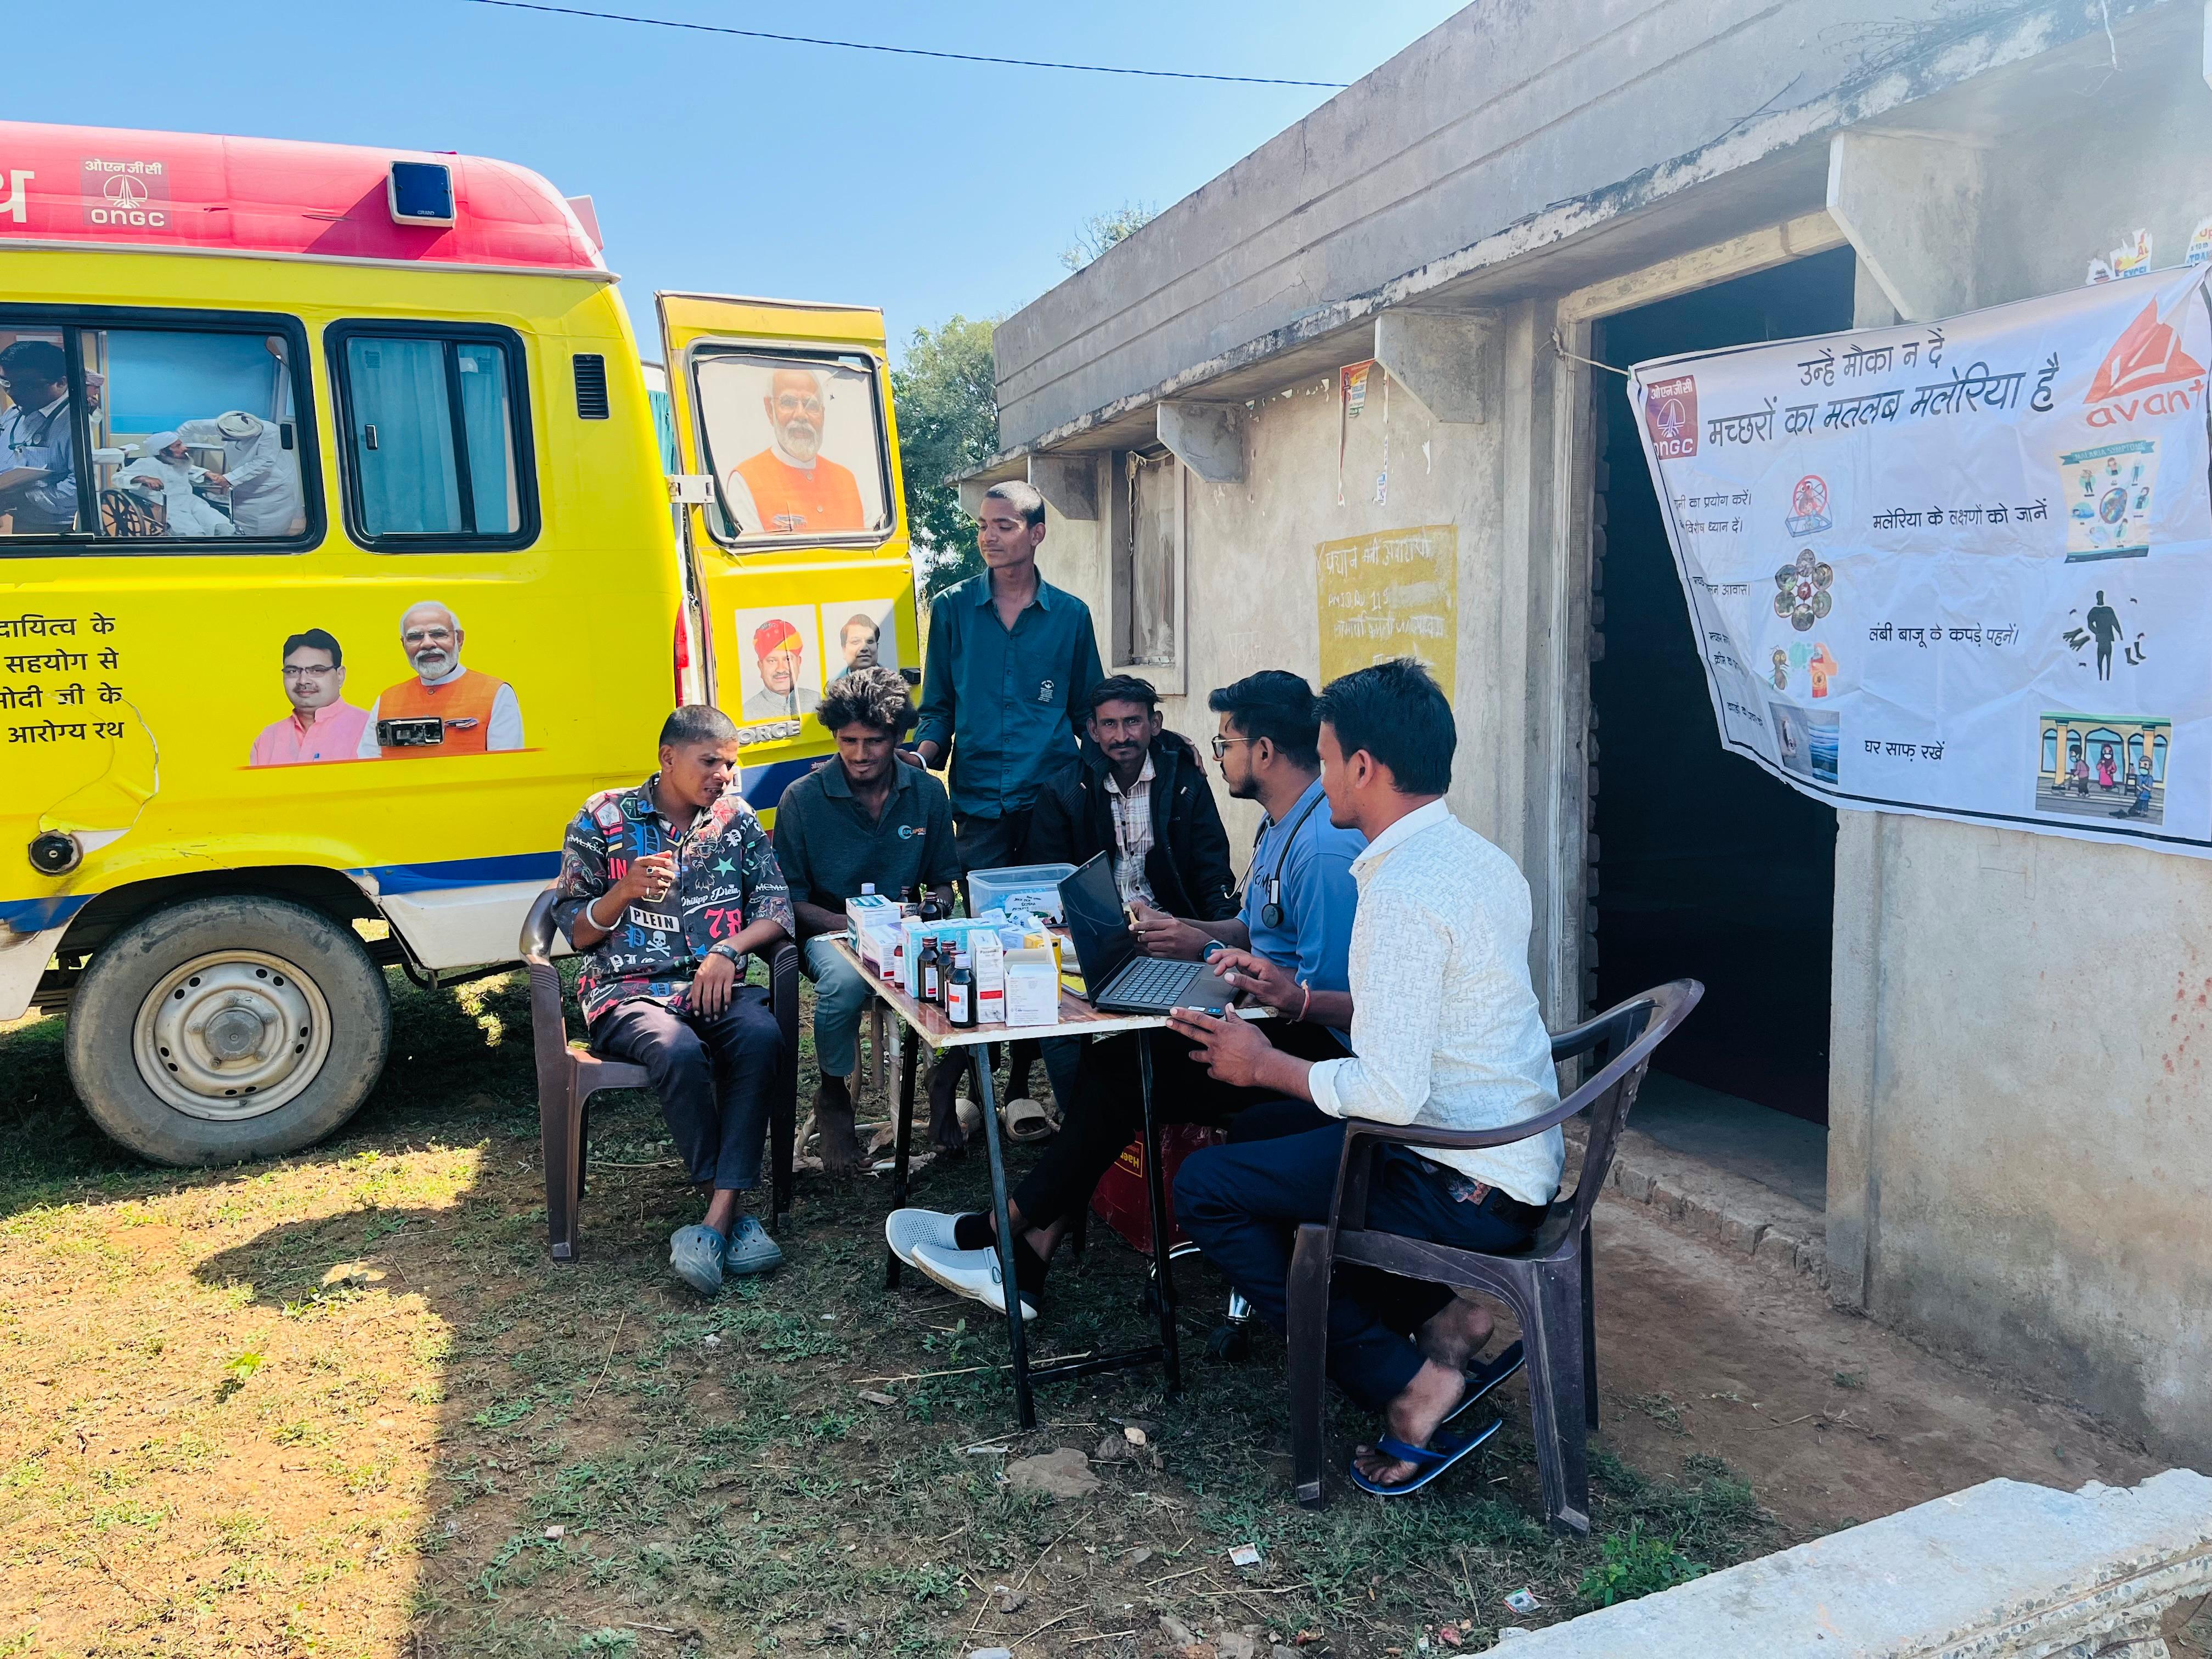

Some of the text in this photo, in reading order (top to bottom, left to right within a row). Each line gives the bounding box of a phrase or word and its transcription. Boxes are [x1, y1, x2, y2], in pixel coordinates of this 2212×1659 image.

[85, 159, 162, 175] ओएनजीसी
[91, 208, 165, 227] ONGC
[1798, 328, 1945, 386] उन्हें मौका न दें
[1651, 378, 1693, 400] ओएनजीसी
[1708, 351, 2060, 447] मच्छरों का मतलब मलेरिया है
[2075, 449, 2107, 460] MALARIA
[1703, 492, 1729, 509] प्रयोग
[1872, 498, 2048, 529] मलेरिया के लक्षणों को जानें
[1708, 522, 1729, 533] ध्यान
[89, 612, 115, 634] के
[1869, 622, 1893, 641] लंबी
[1898, 628, 1927, 649] बाजू
[1929, 623, 1943, 641] के
[1949, 622, 1982, 647] कपड़े
[4, 647, 119, 673] सहयोग से
[55, 683, 85, 706] जी
[97, 682, 123, 704] के
[8, 719, 125, 743] आरोग्य रथ
[737, 720, 800, 745] ORCE
[1865, 740, 1881, 754] घर
[1921, 740, 1945, 760] रखें
[634, 910, 674, 928] PLEIN
